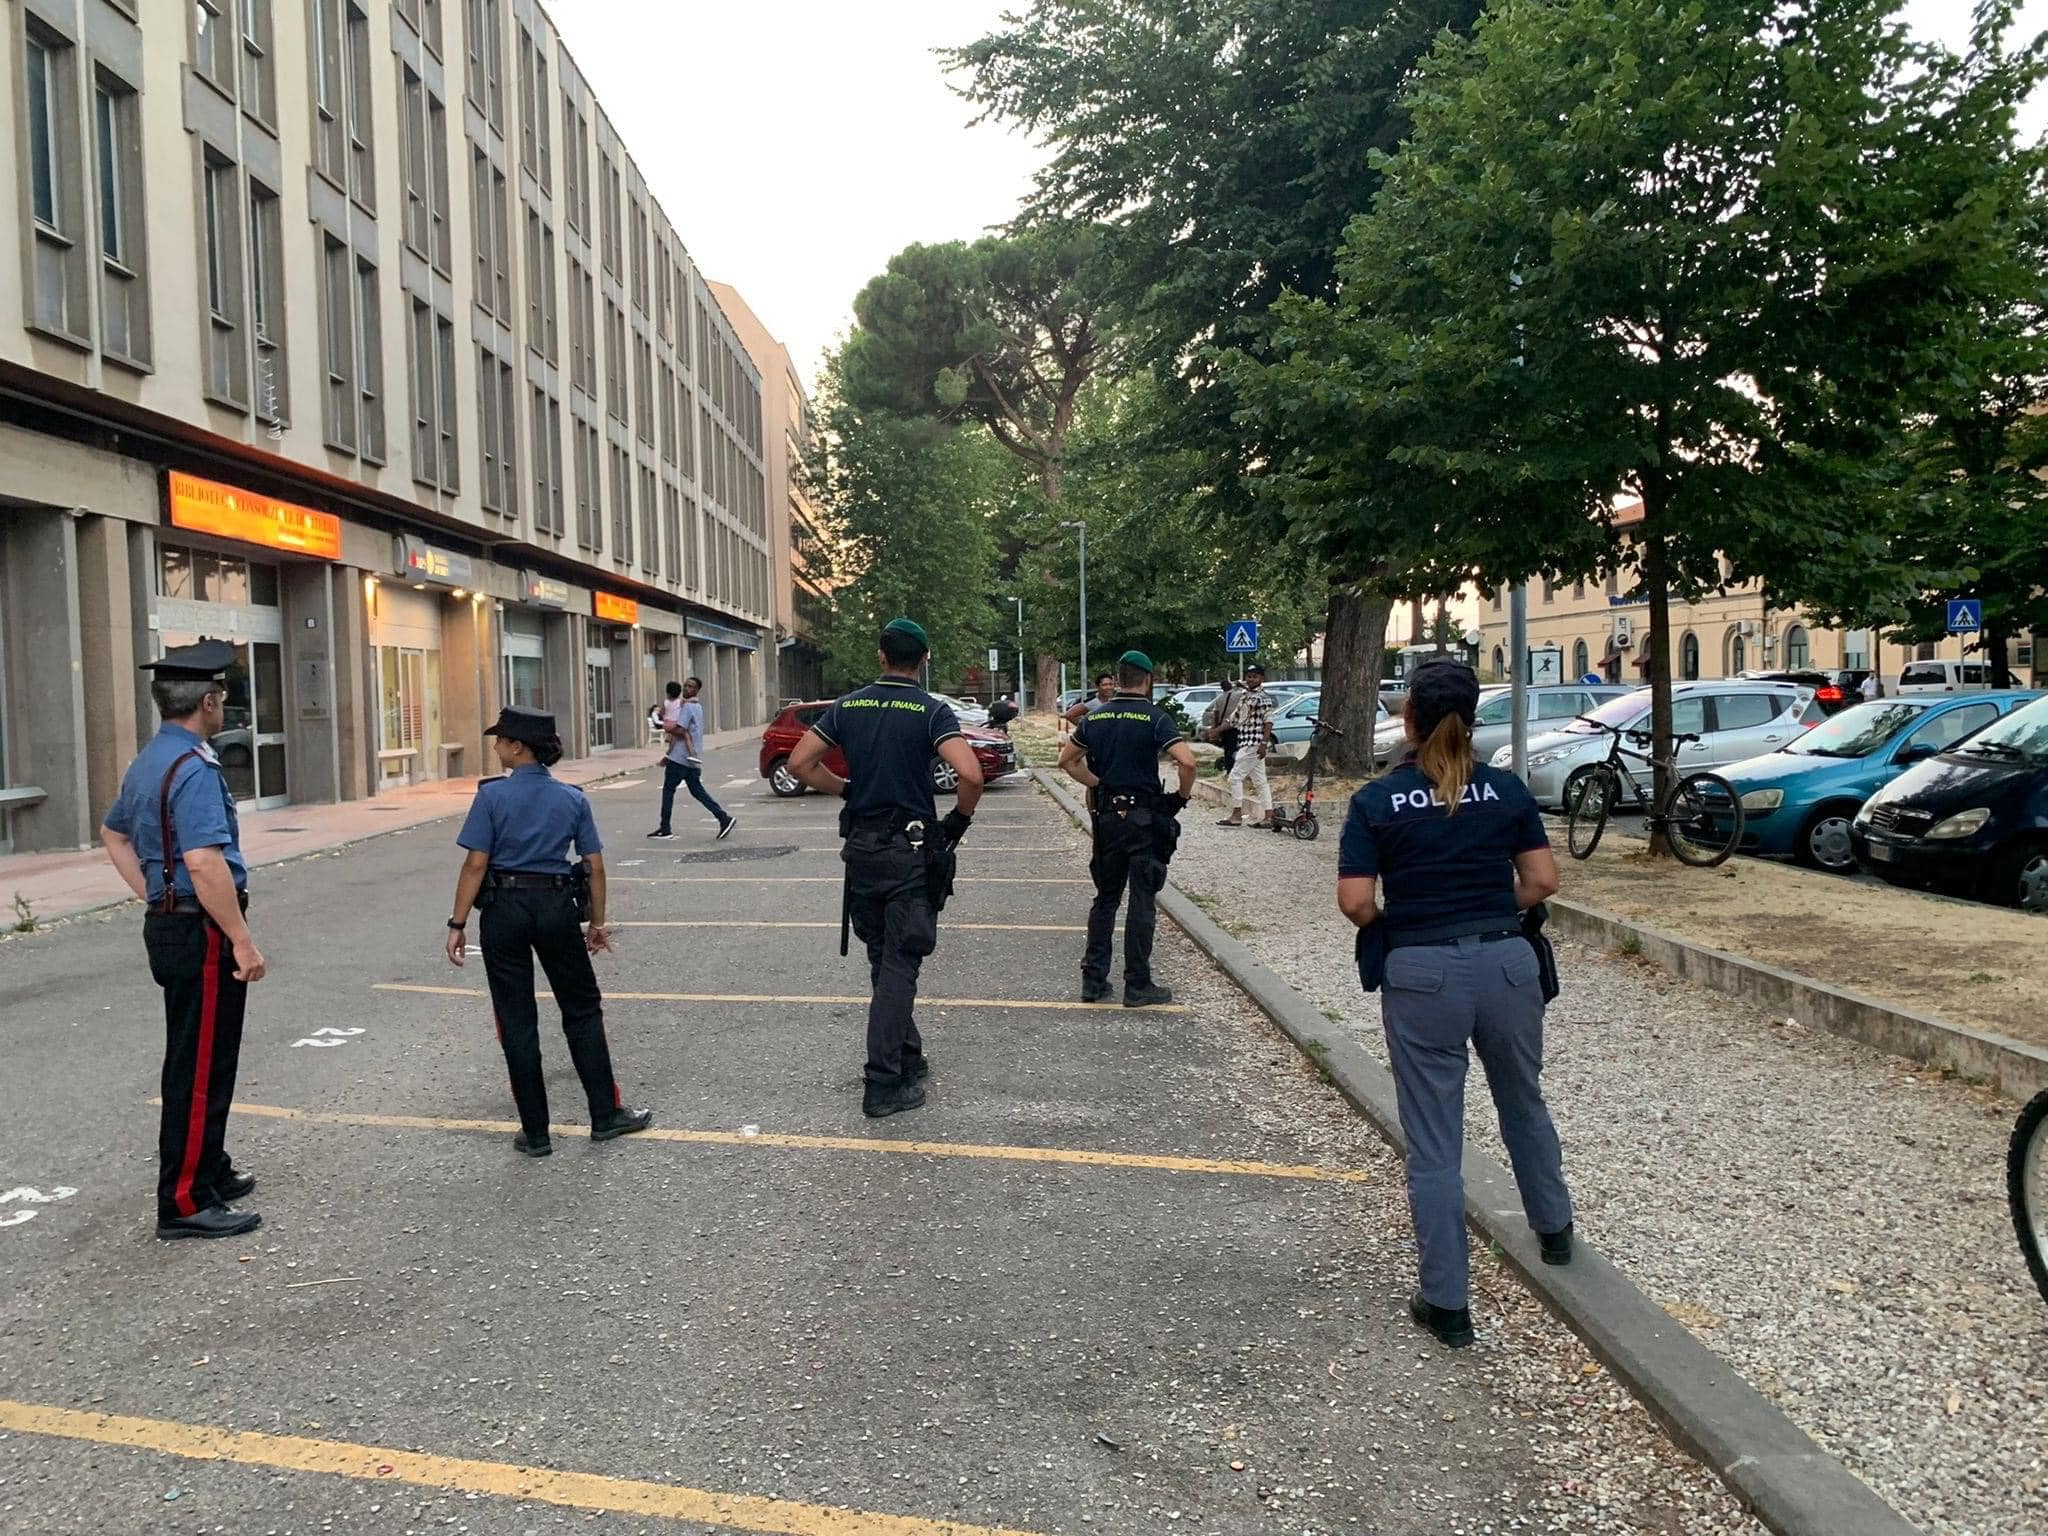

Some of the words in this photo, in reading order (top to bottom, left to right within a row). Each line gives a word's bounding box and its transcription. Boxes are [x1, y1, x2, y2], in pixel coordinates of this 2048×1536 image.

[842, 700, 879, 708] GUARDIA
[890, 700, 925, 712] FINANZA
[1087, 712, 1115, 721] GUARDIA
[1123, 712, 1151, 721] FINANZA
